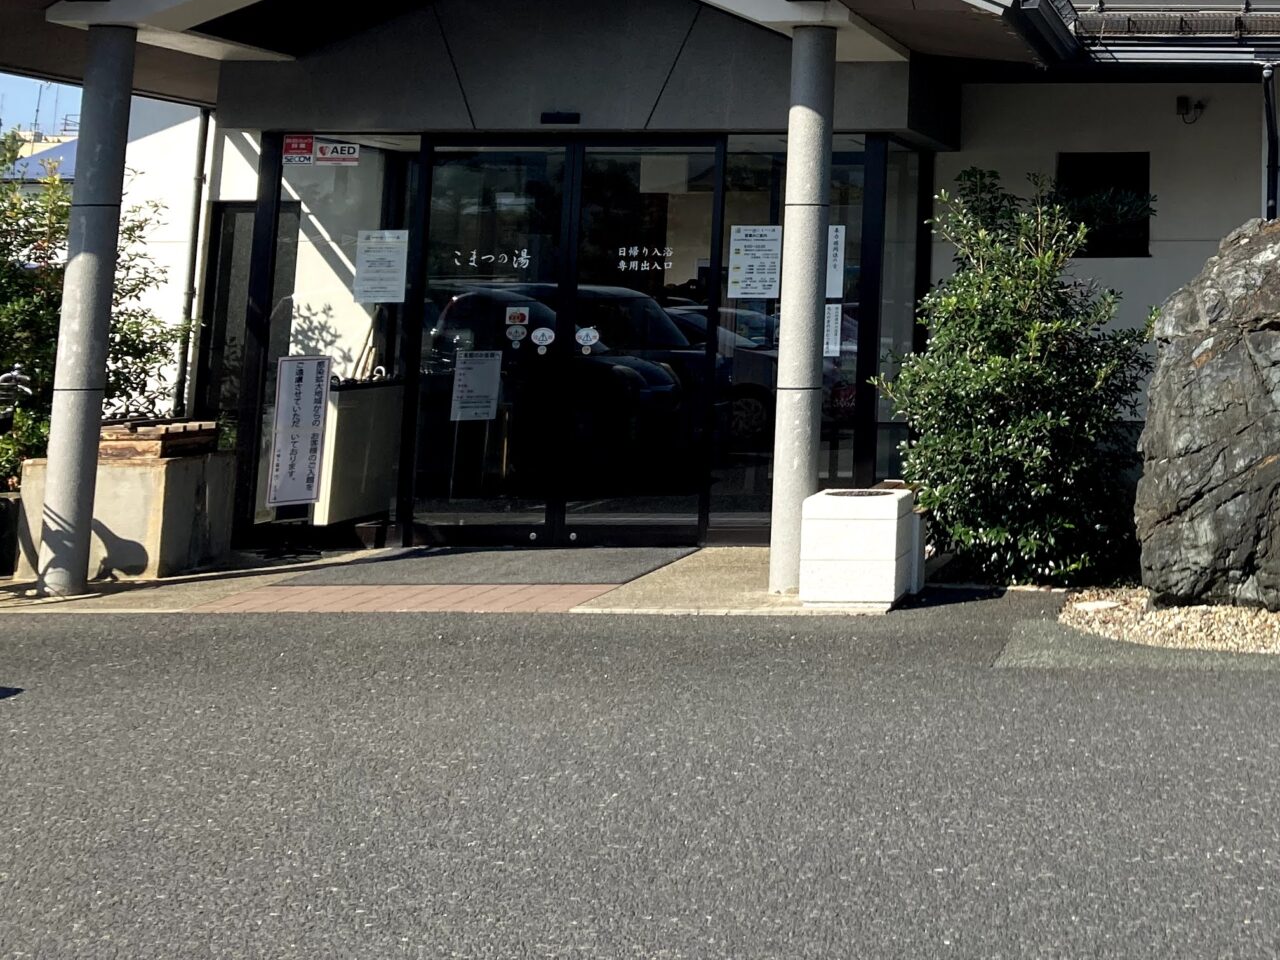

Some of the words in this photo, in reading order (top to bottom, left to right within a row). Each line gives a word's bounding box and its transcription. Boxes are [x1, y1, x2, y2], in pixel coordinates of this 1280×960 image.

[331, 146, 356, 155] AED
[284, 155, 311, 163] SECOM
[617, 246, 674, 257] 日帰り入浴
[453, 248, 532, 269] こまつの湯
[617, 259, 673, 271] 専用出入口
